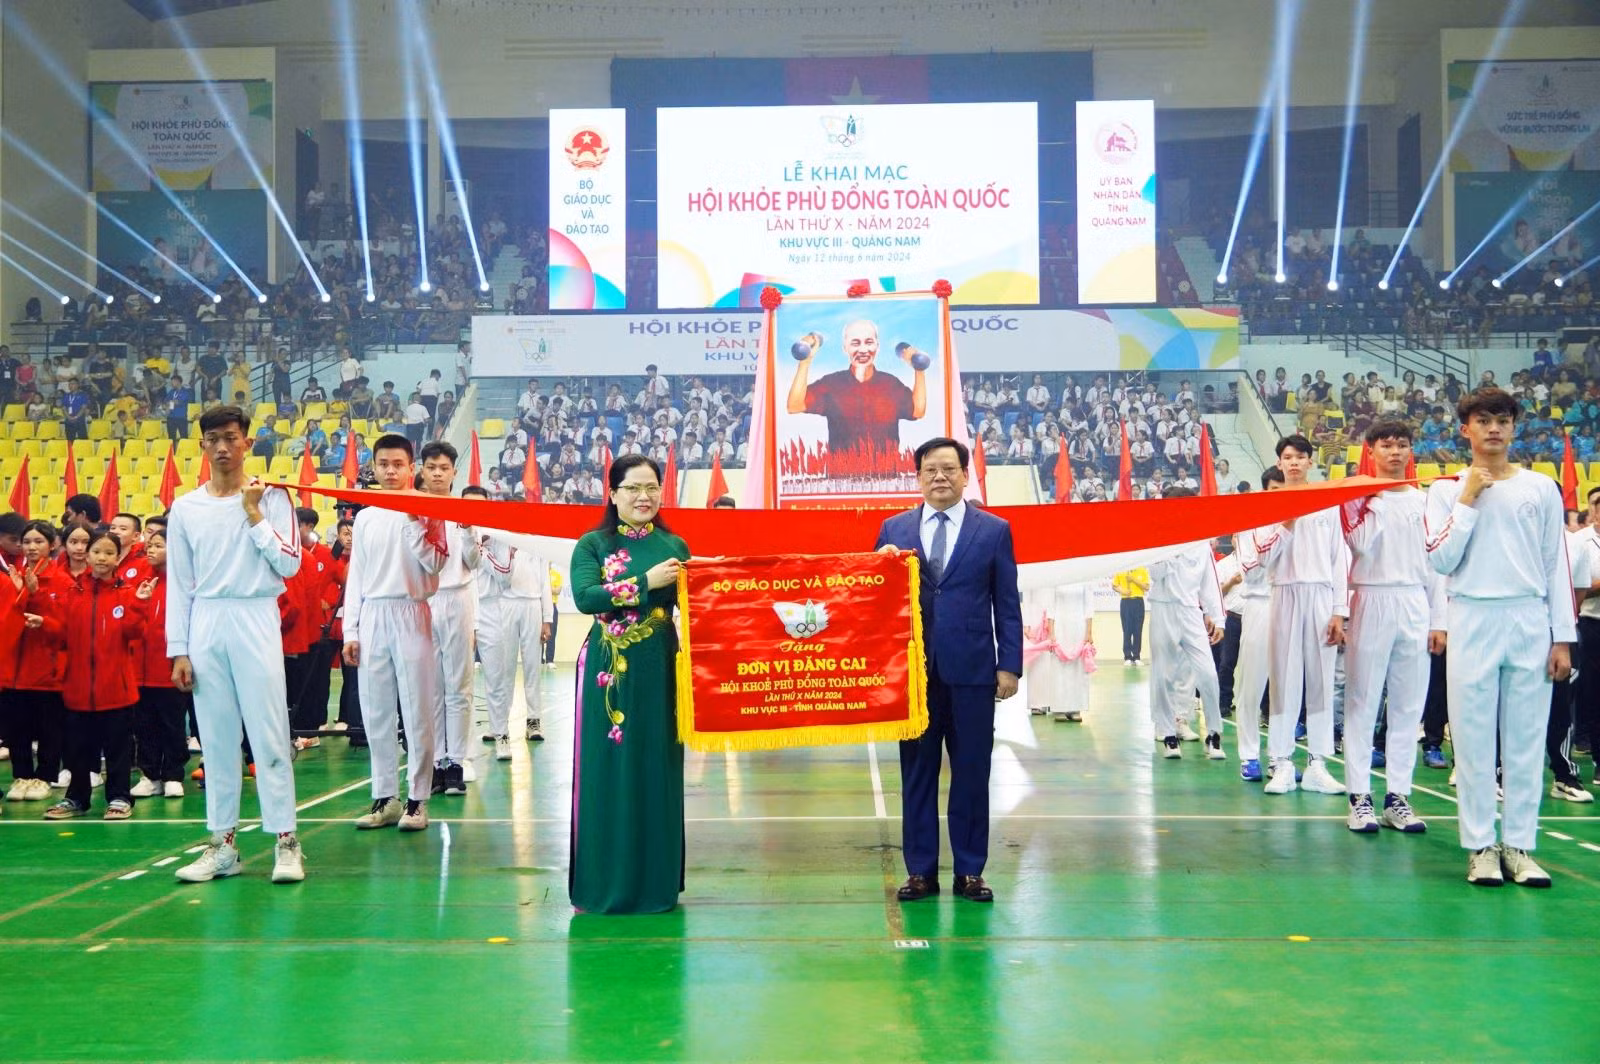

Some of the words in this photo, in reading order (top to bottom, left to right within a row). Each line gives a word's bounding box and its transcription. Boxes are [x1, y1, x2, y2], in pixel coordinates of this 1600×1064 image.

[784, 160, 804, 182] LỄ
[811, 165, 857, 181] KHAI
[865, 165, 909, 184] MẠC
[579, 177, 594, 192] BỘ
[1114, 176, 1133, 186] BAN
[563, 192, 588, 205] GIÁO
[590, 194, 612, 207] DỤC
[688, 187, 722, 217] HỘI
[728, 186, 781, 211] KHỎE
[787, 185, 826, 211] PHÙ
[831, 182, 889, 210] ĐỔNG
[894, 184, 947, 210] TOÀN
[953, 182, 1010, 212] QUỐC
[581, 207, 594, 219] VÀ
[766, 214, 794, 232] LẦN
[798, 214, 832, 231] THỨ
[834, 218, 844, 231] X
[857, 214, 892, 230] NĂM
[896, 217, 930, 230] 2024
[1125, 216, 1146, 226] NAM
[589, 224, 609, 236] TẠO
[779, 237, 803, 248] KHU
[805, 236, 830, 250] VỰC
[832, 237, 842, 247] III
[895, 236, 921, 247] NAM
[788, 254, 811, 265] Ngày
[814, 254, 825, 263] 12
[828, 253, 854, 264] tháng
[866, 254, 884, 262] năm
[888, 252, 911, 262] 2024
[629, 319, 670, 336] HỘI
[678, 317, 742, 334] KHỎE
[951, 314, 1019, 333] QUỐC
[705, 336, 746, 349] LẦN
[705, 352, 744, 361] KHU
[713, 580, 731, 593] BỘ
[734, 578, 769, 591] GIÁO
[773, 579, 800, 592] DỤC
[803, 575, 822, 588] VÀ
[826, 574, 856, 588] ĐÀO
[858, 575, 885, 588] TẠO
[779, 641, 826, 654] Tặng
[737, 660, 771, 675] ĐƠN
[773, 660, 790, 676] VỊ
[793, 656, 837, 671] ĐĂNG
[840, 657, 867, 670] CAI
[720, 680, 740, 693] HỘI
[774, 678, 794, 690] PHÙ
[796, 673, 826, 689] ĐỔNG
[828, 675, 856, 688] TOÀN
[858, 672, 886, 687] QUỐC
[764, 692, 780, 702] LẦN
[796, 692, 803, 700] X
[804, 690, 823, 700] NĂM
[824, 691, 842, 699] 2024
[780, 705, 788, 713] III
[794, 702, 813, 711] TỈNH
[815, 701, 845, 711] QUẢNG
[847, 702, 867, 710] NAM
